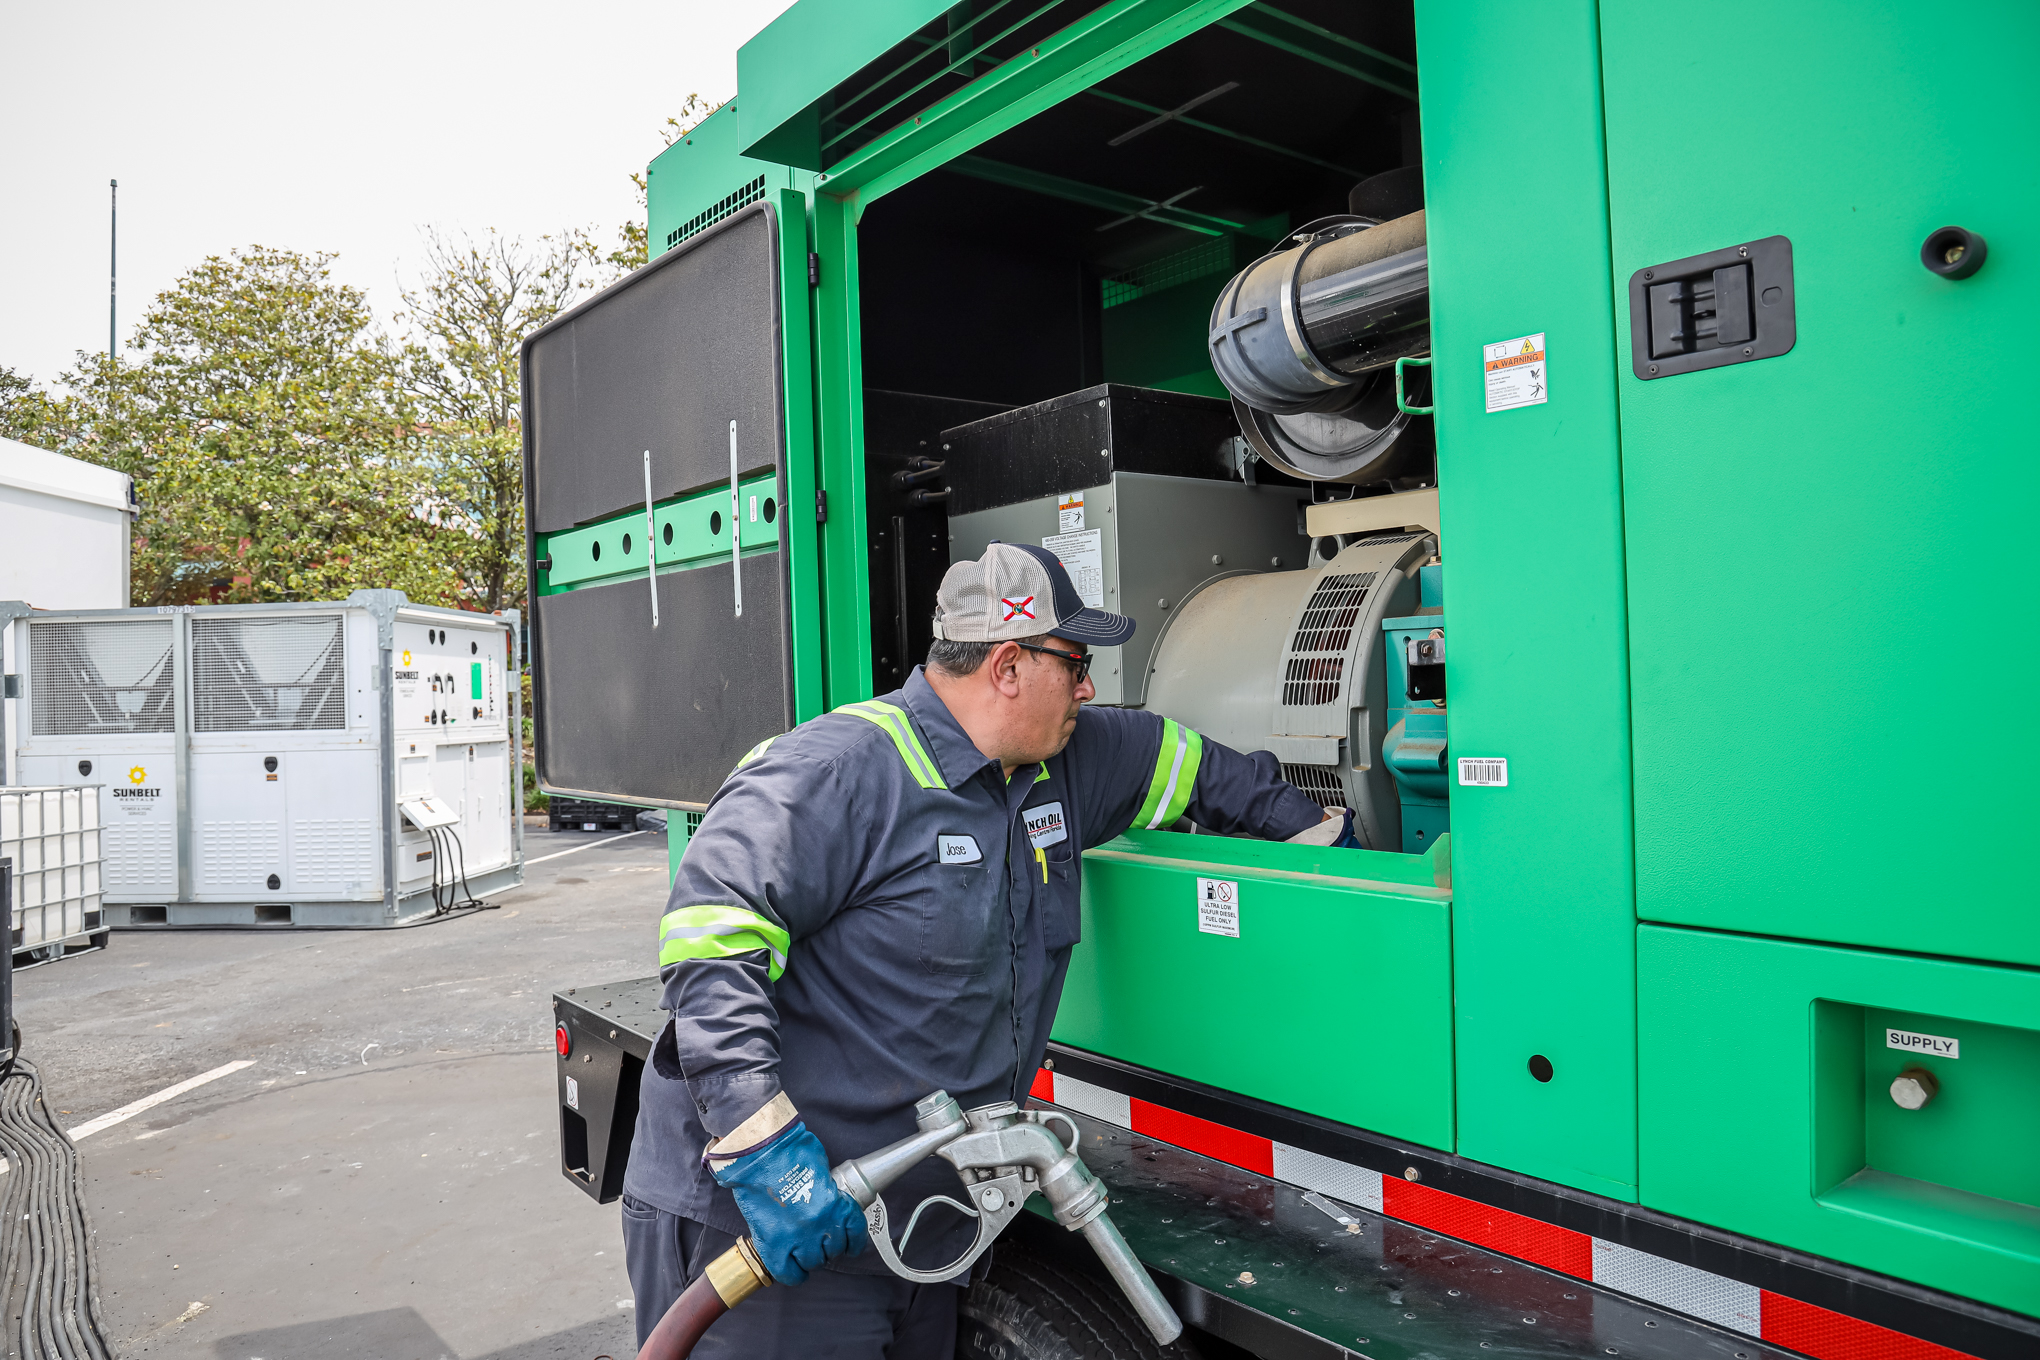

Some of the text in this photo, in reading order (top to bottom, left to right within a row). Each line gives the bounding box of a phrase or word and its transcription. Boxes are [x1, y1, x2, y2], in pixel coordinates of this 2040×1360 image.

[1501, 353, 1539, 367] WARNING
[395, 671, 418, 679] SUNBELT
[113, 788, 161, 797] SUNBELT
[1026, 812, 1062, 831] NCH OIL
[946, 842, 967, 856] Jose
[1890, 1032, 1953, 1052] SUPPLY
[780, 1180, 804, 1203] SAFETY
